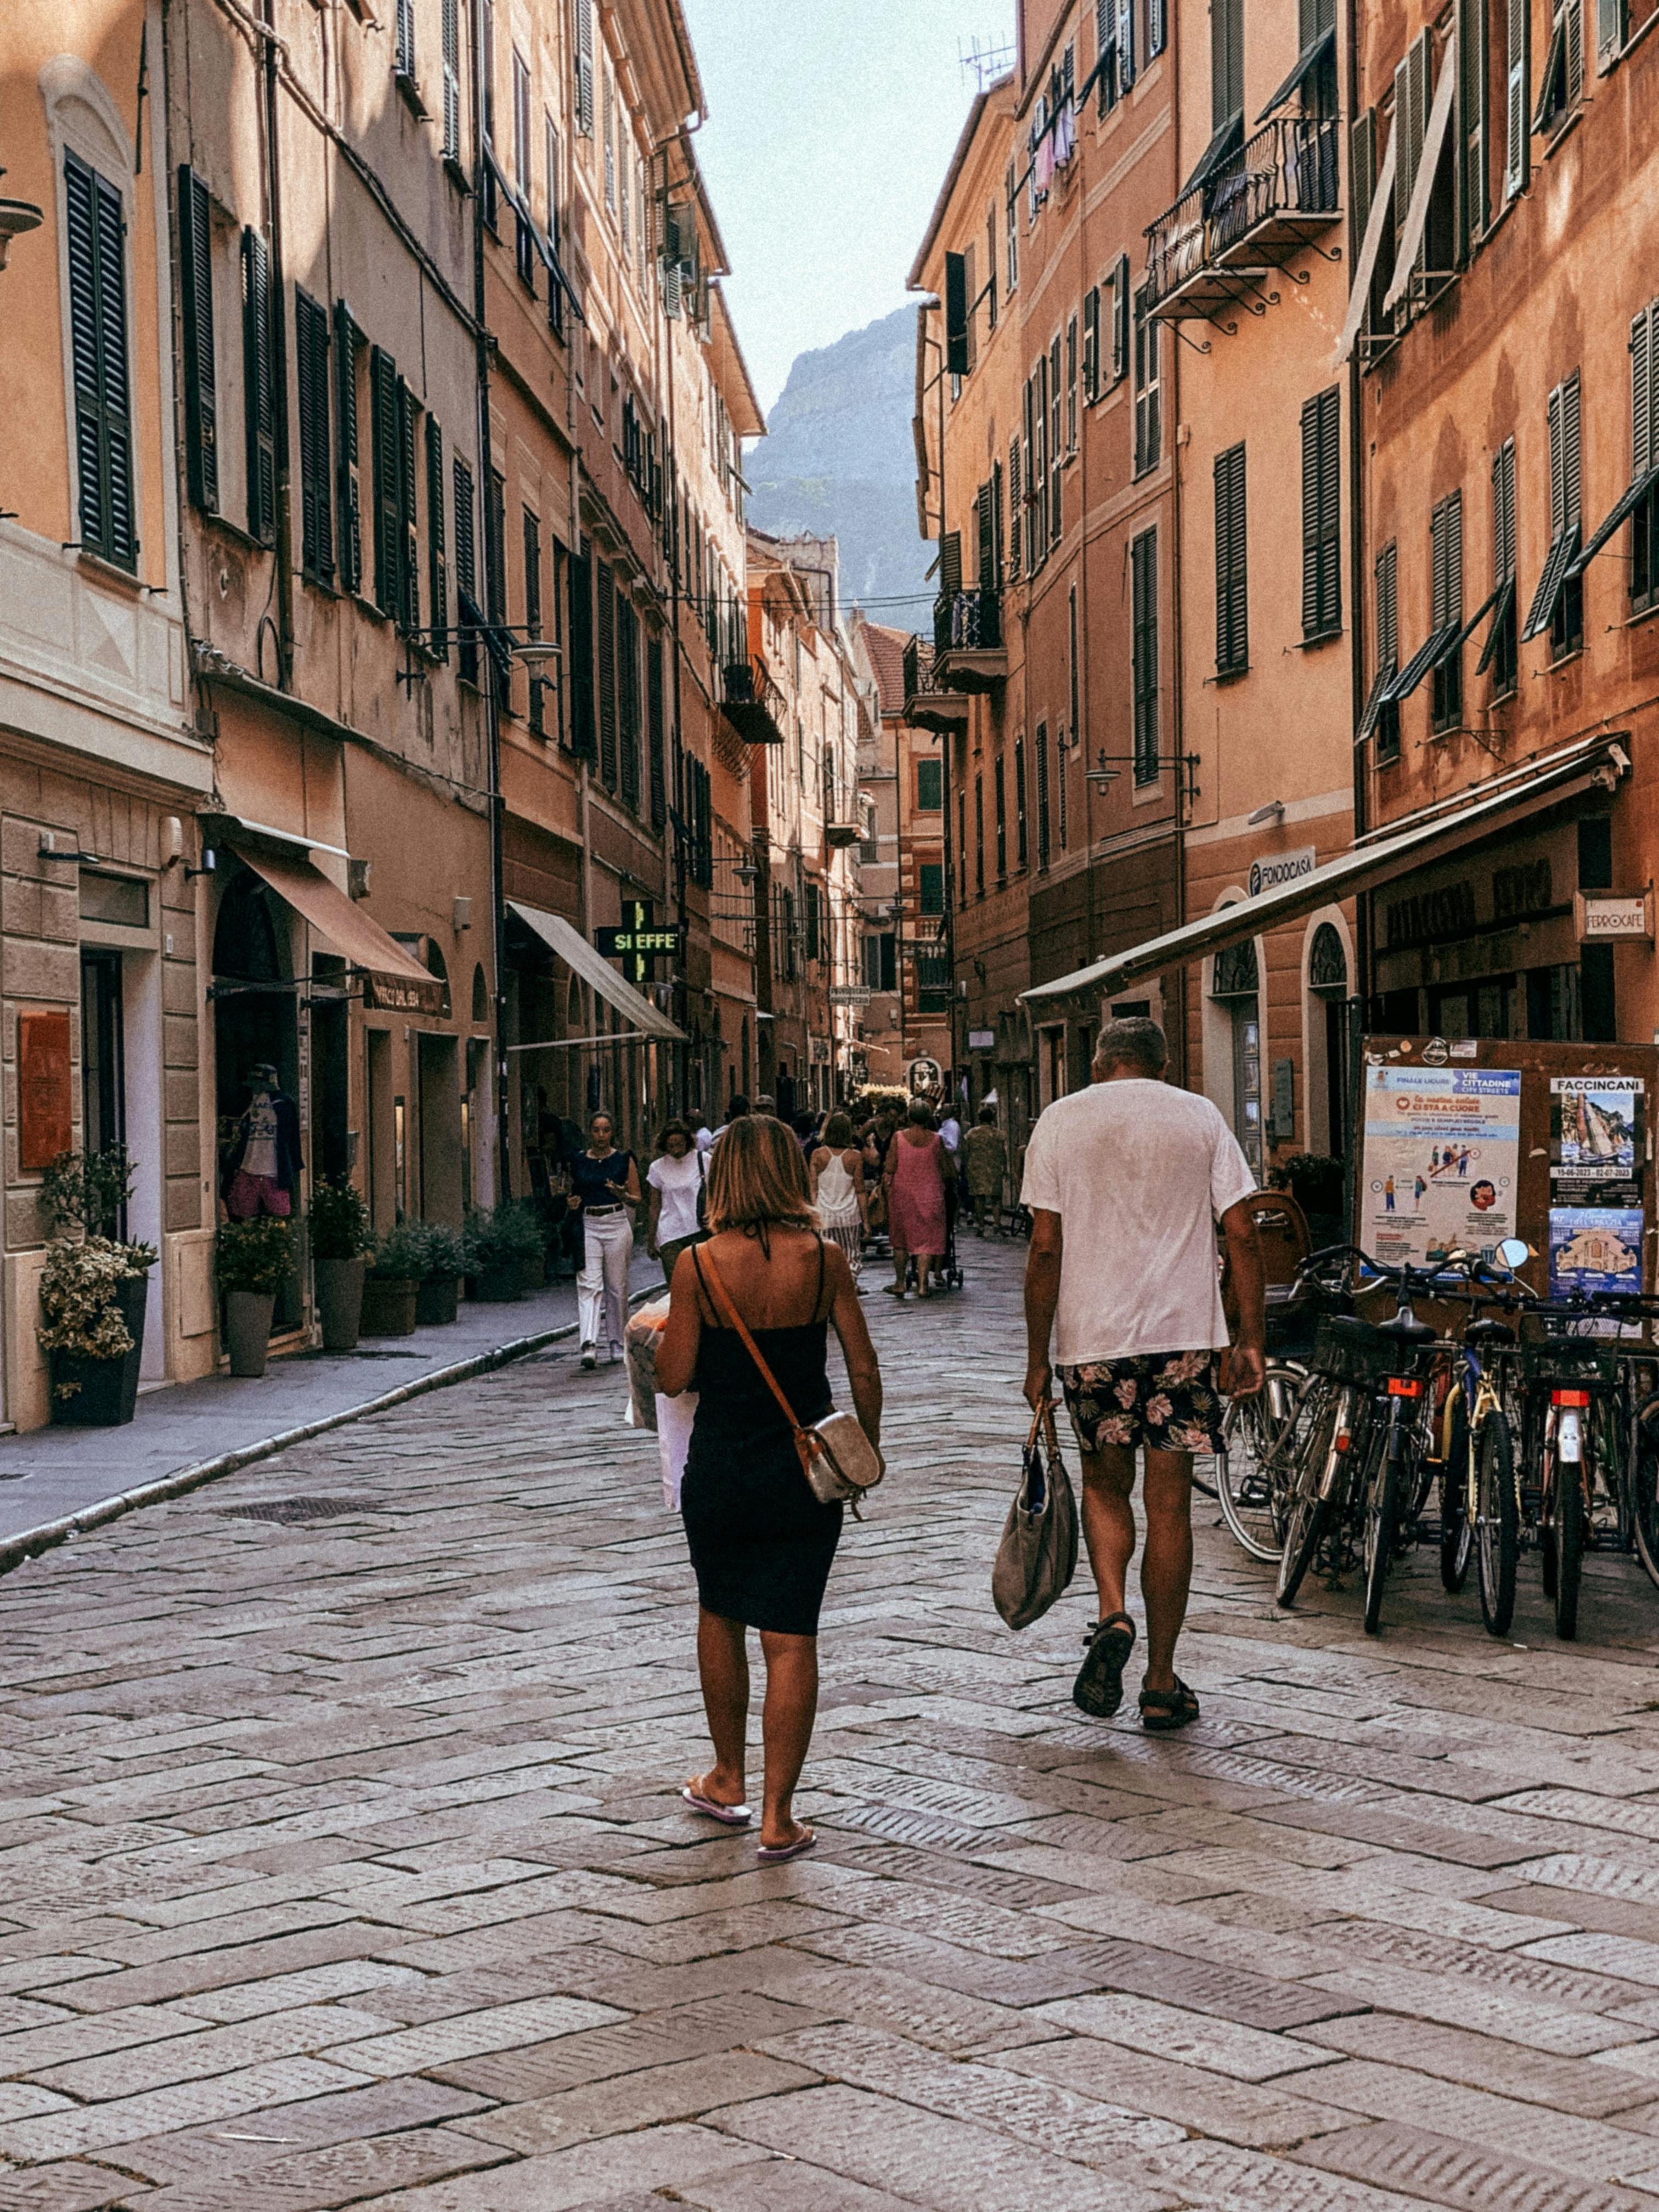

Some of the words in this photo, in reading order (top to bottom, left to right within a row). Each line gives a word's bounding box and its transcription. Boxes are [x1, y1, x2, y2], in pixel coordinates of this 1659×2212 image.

[1262, 858, 1312, 885] FONDOCASA
[1587, 913, 1643, 928] FERROCAFE
[614, 934, 631, 949] SI
[1462, 1079, 1511, 1088] CITTADINE
[1558, 1080, 1639, 1091] FACCINCANI
[1449, 1104, 1480, 1113] CUORE
